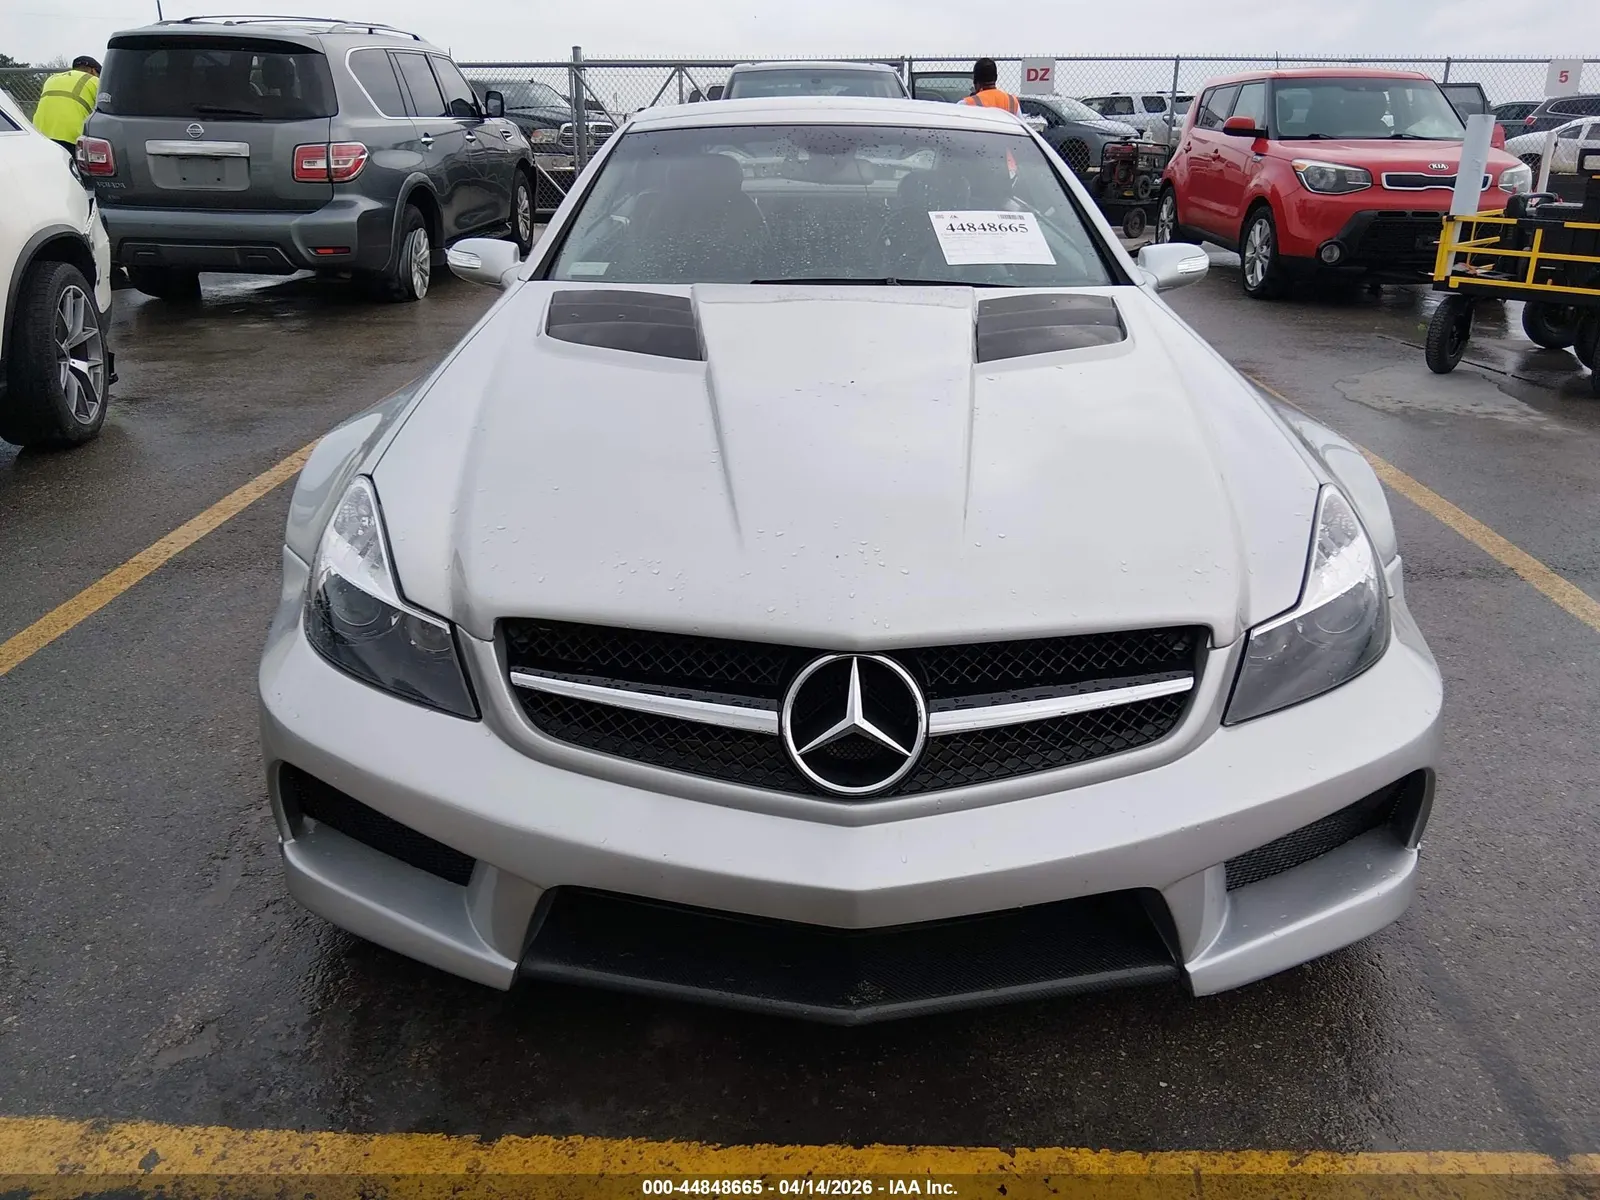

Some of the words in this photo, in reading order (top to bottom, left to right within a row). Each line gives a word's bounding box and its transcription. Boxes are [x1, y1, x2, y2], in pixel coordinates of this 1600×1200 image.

[1026, 68, 1050, 81] DZ
[1559, 70, 1569, 83] 5
[946, 222, 1029, 233] 44848665
